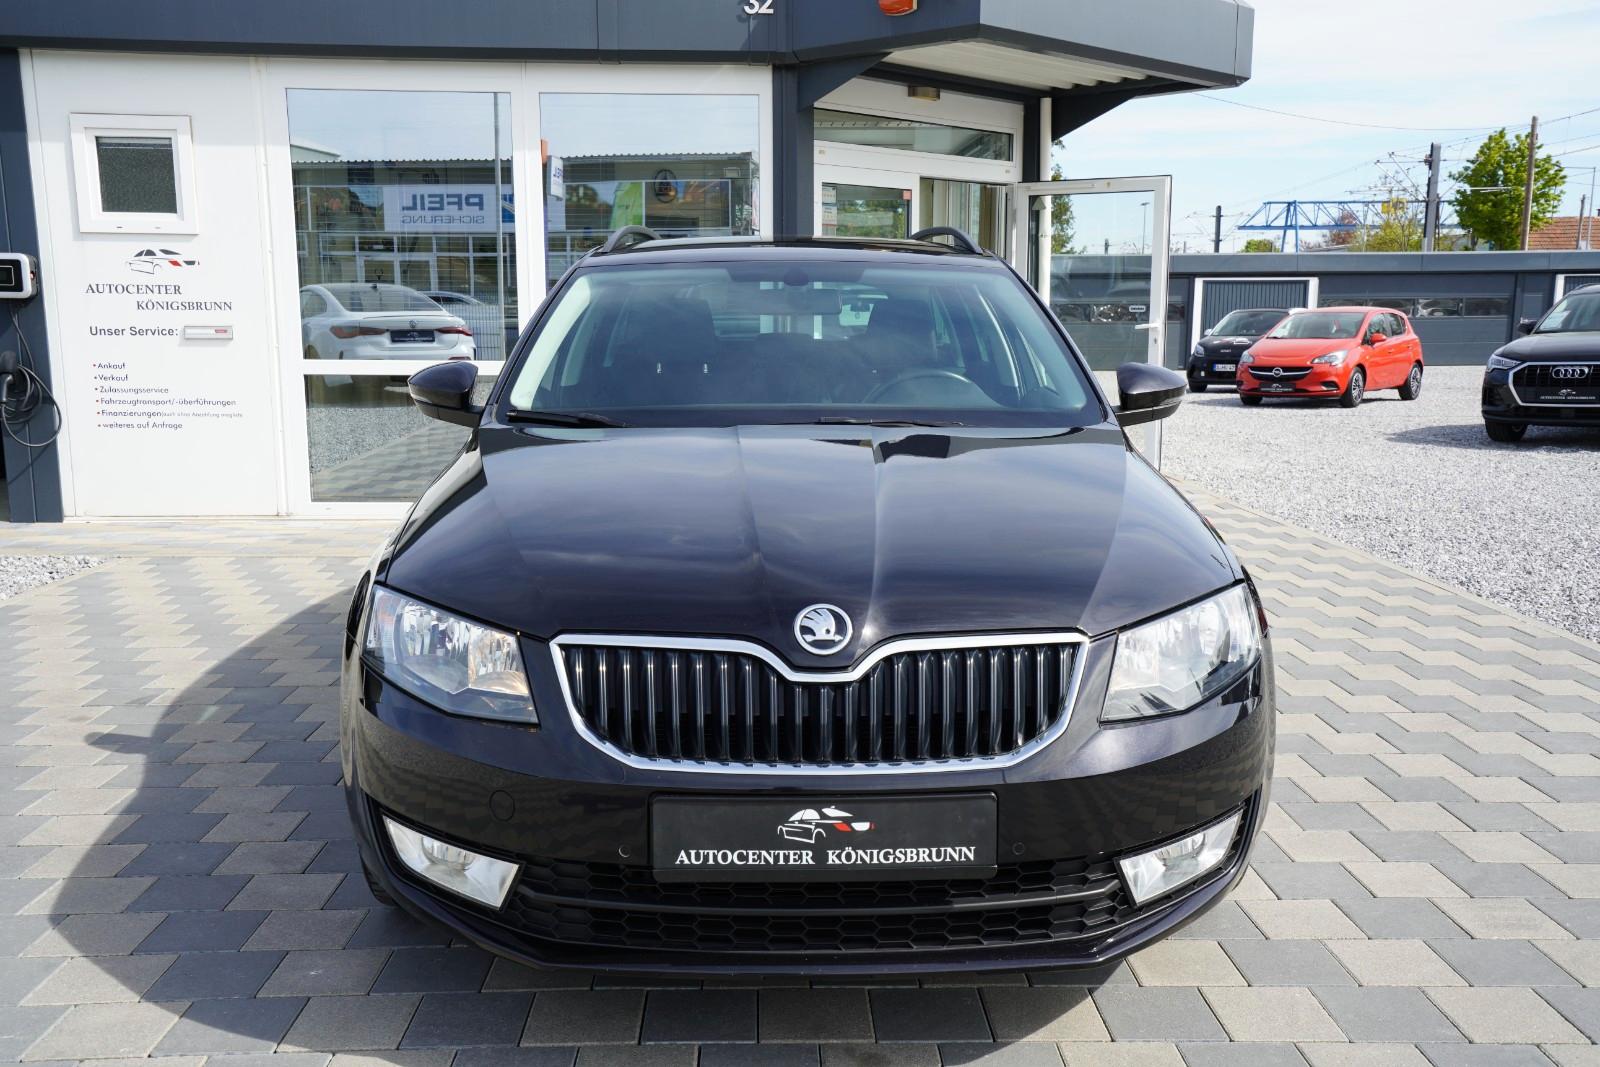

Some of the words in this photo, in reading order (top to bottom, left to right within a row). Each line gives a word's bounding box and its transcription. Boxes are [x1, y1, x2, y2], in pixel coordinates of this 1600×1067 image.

[85, 283, 183, 295] AUTOCENTER
[136, 299, 233, 311] KÖNIGSBRUNN
[89, 326, 126, 336] Unser
[129, 326, 179, 336] Service:
[97, 362, 126, 370] Ankauf
[98, 374, 128, 382] Verkauf
[99, 386, 169, 394] Zulassungsservice
[102, 421, 135, 429] weiteres
[136, 421, 150, 429] auf
[152, 421, 183, 430] Anfrage
[675, 849, 815, 865] AUTOCENTER
[827, 846, 976, 865] KÖNIGSBRUNN
